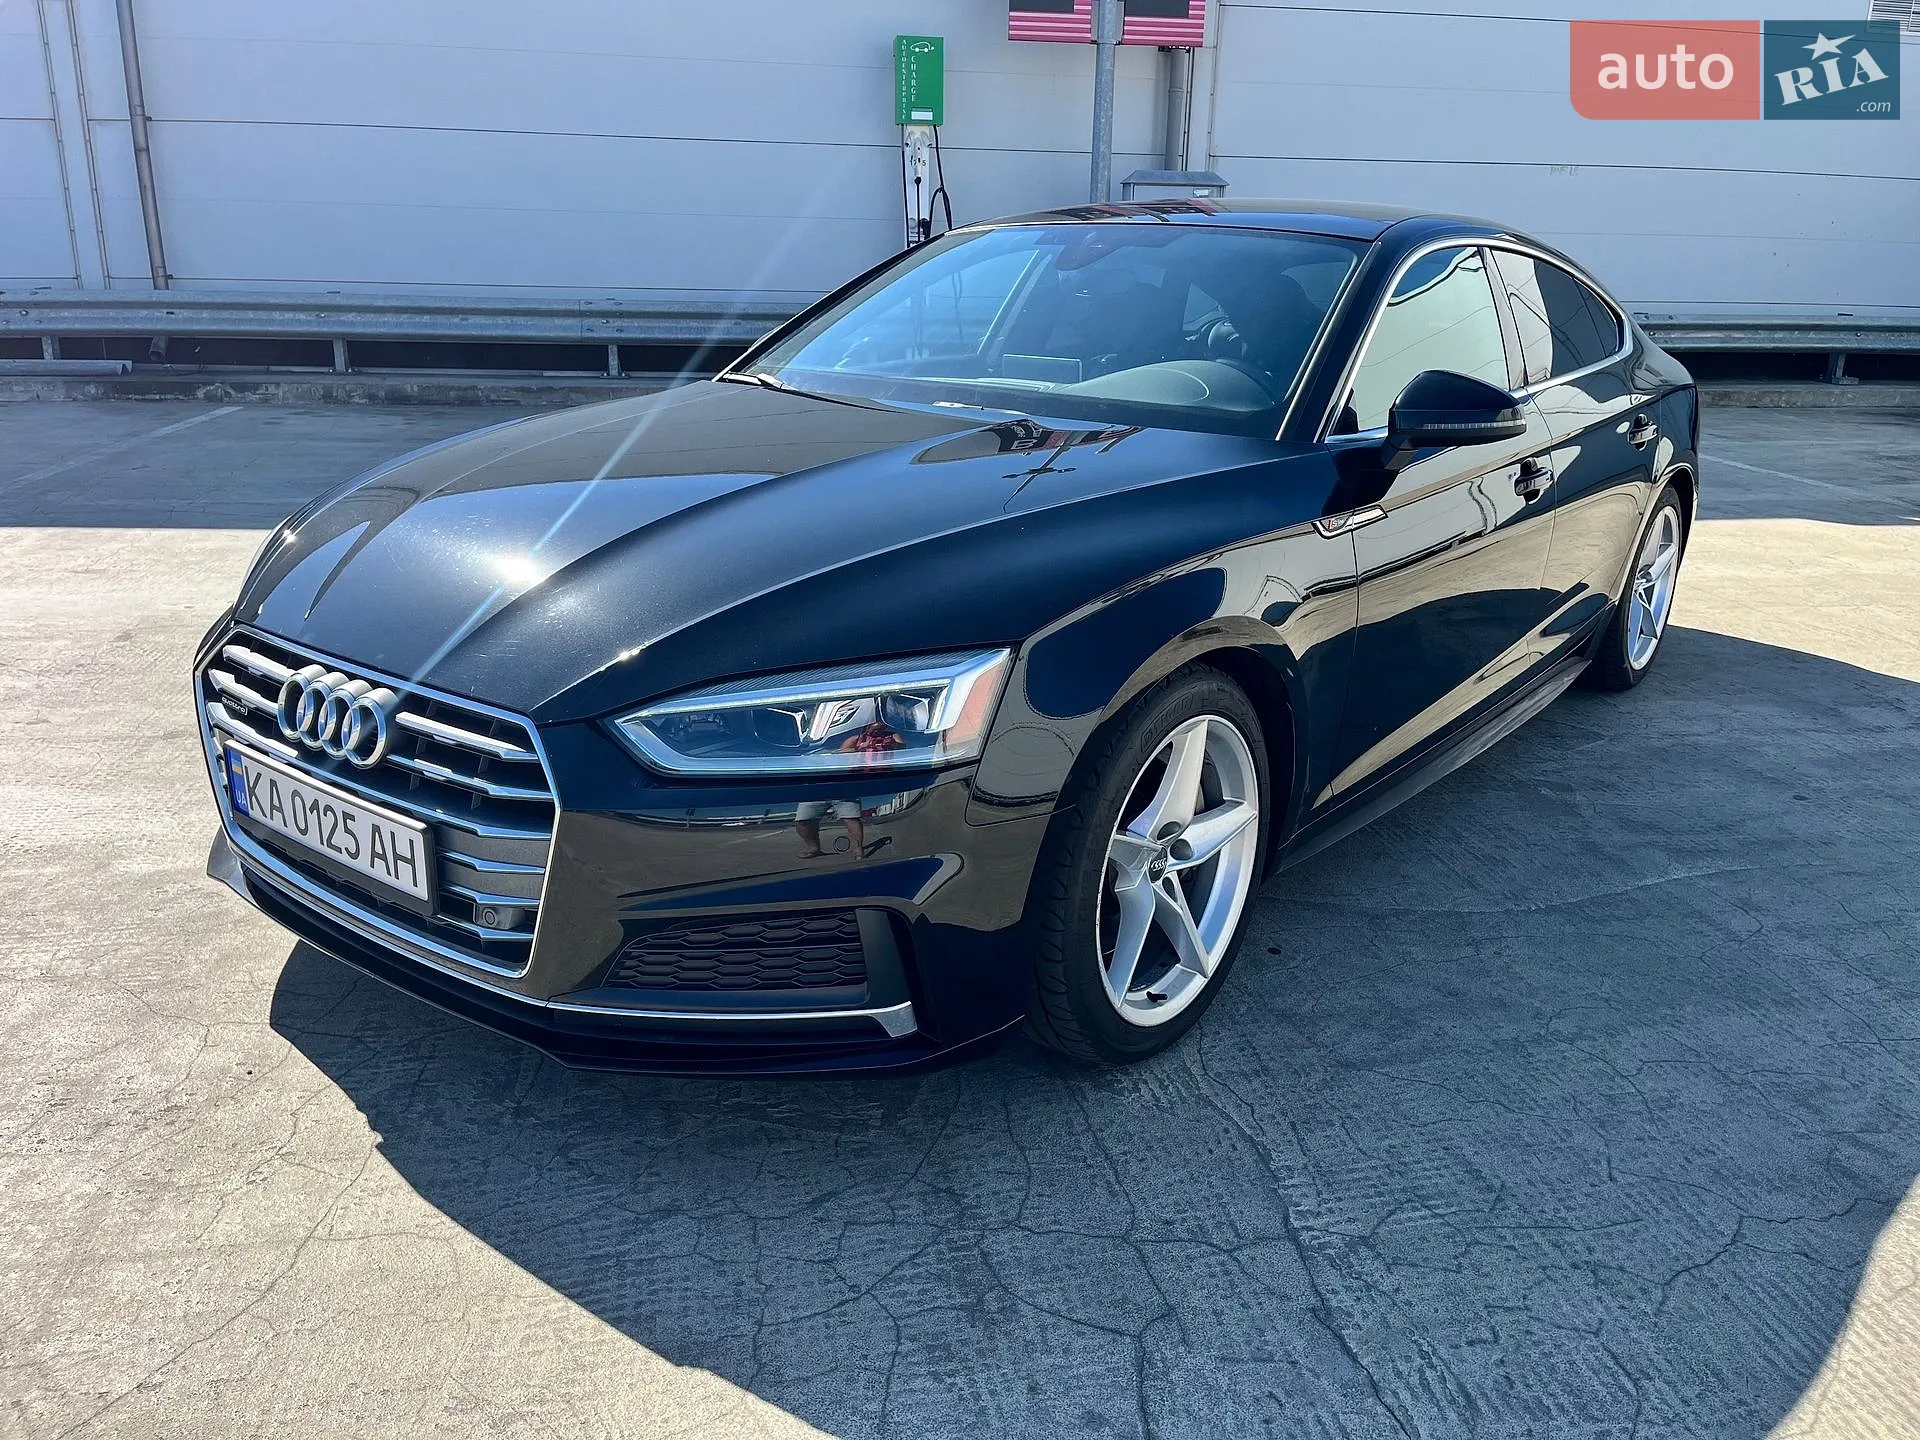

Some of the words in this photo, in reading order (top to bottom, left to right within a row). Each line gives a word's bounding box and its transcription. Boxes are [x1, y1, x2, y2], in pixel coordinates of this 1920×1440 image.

[221, 696, 246, 713] quattro
[235, 789, 247, 807] UA
[244, 765, 288, 828] KA
[291, 789, 361, 860] 0125
[369, 823, 418, 888] AH
